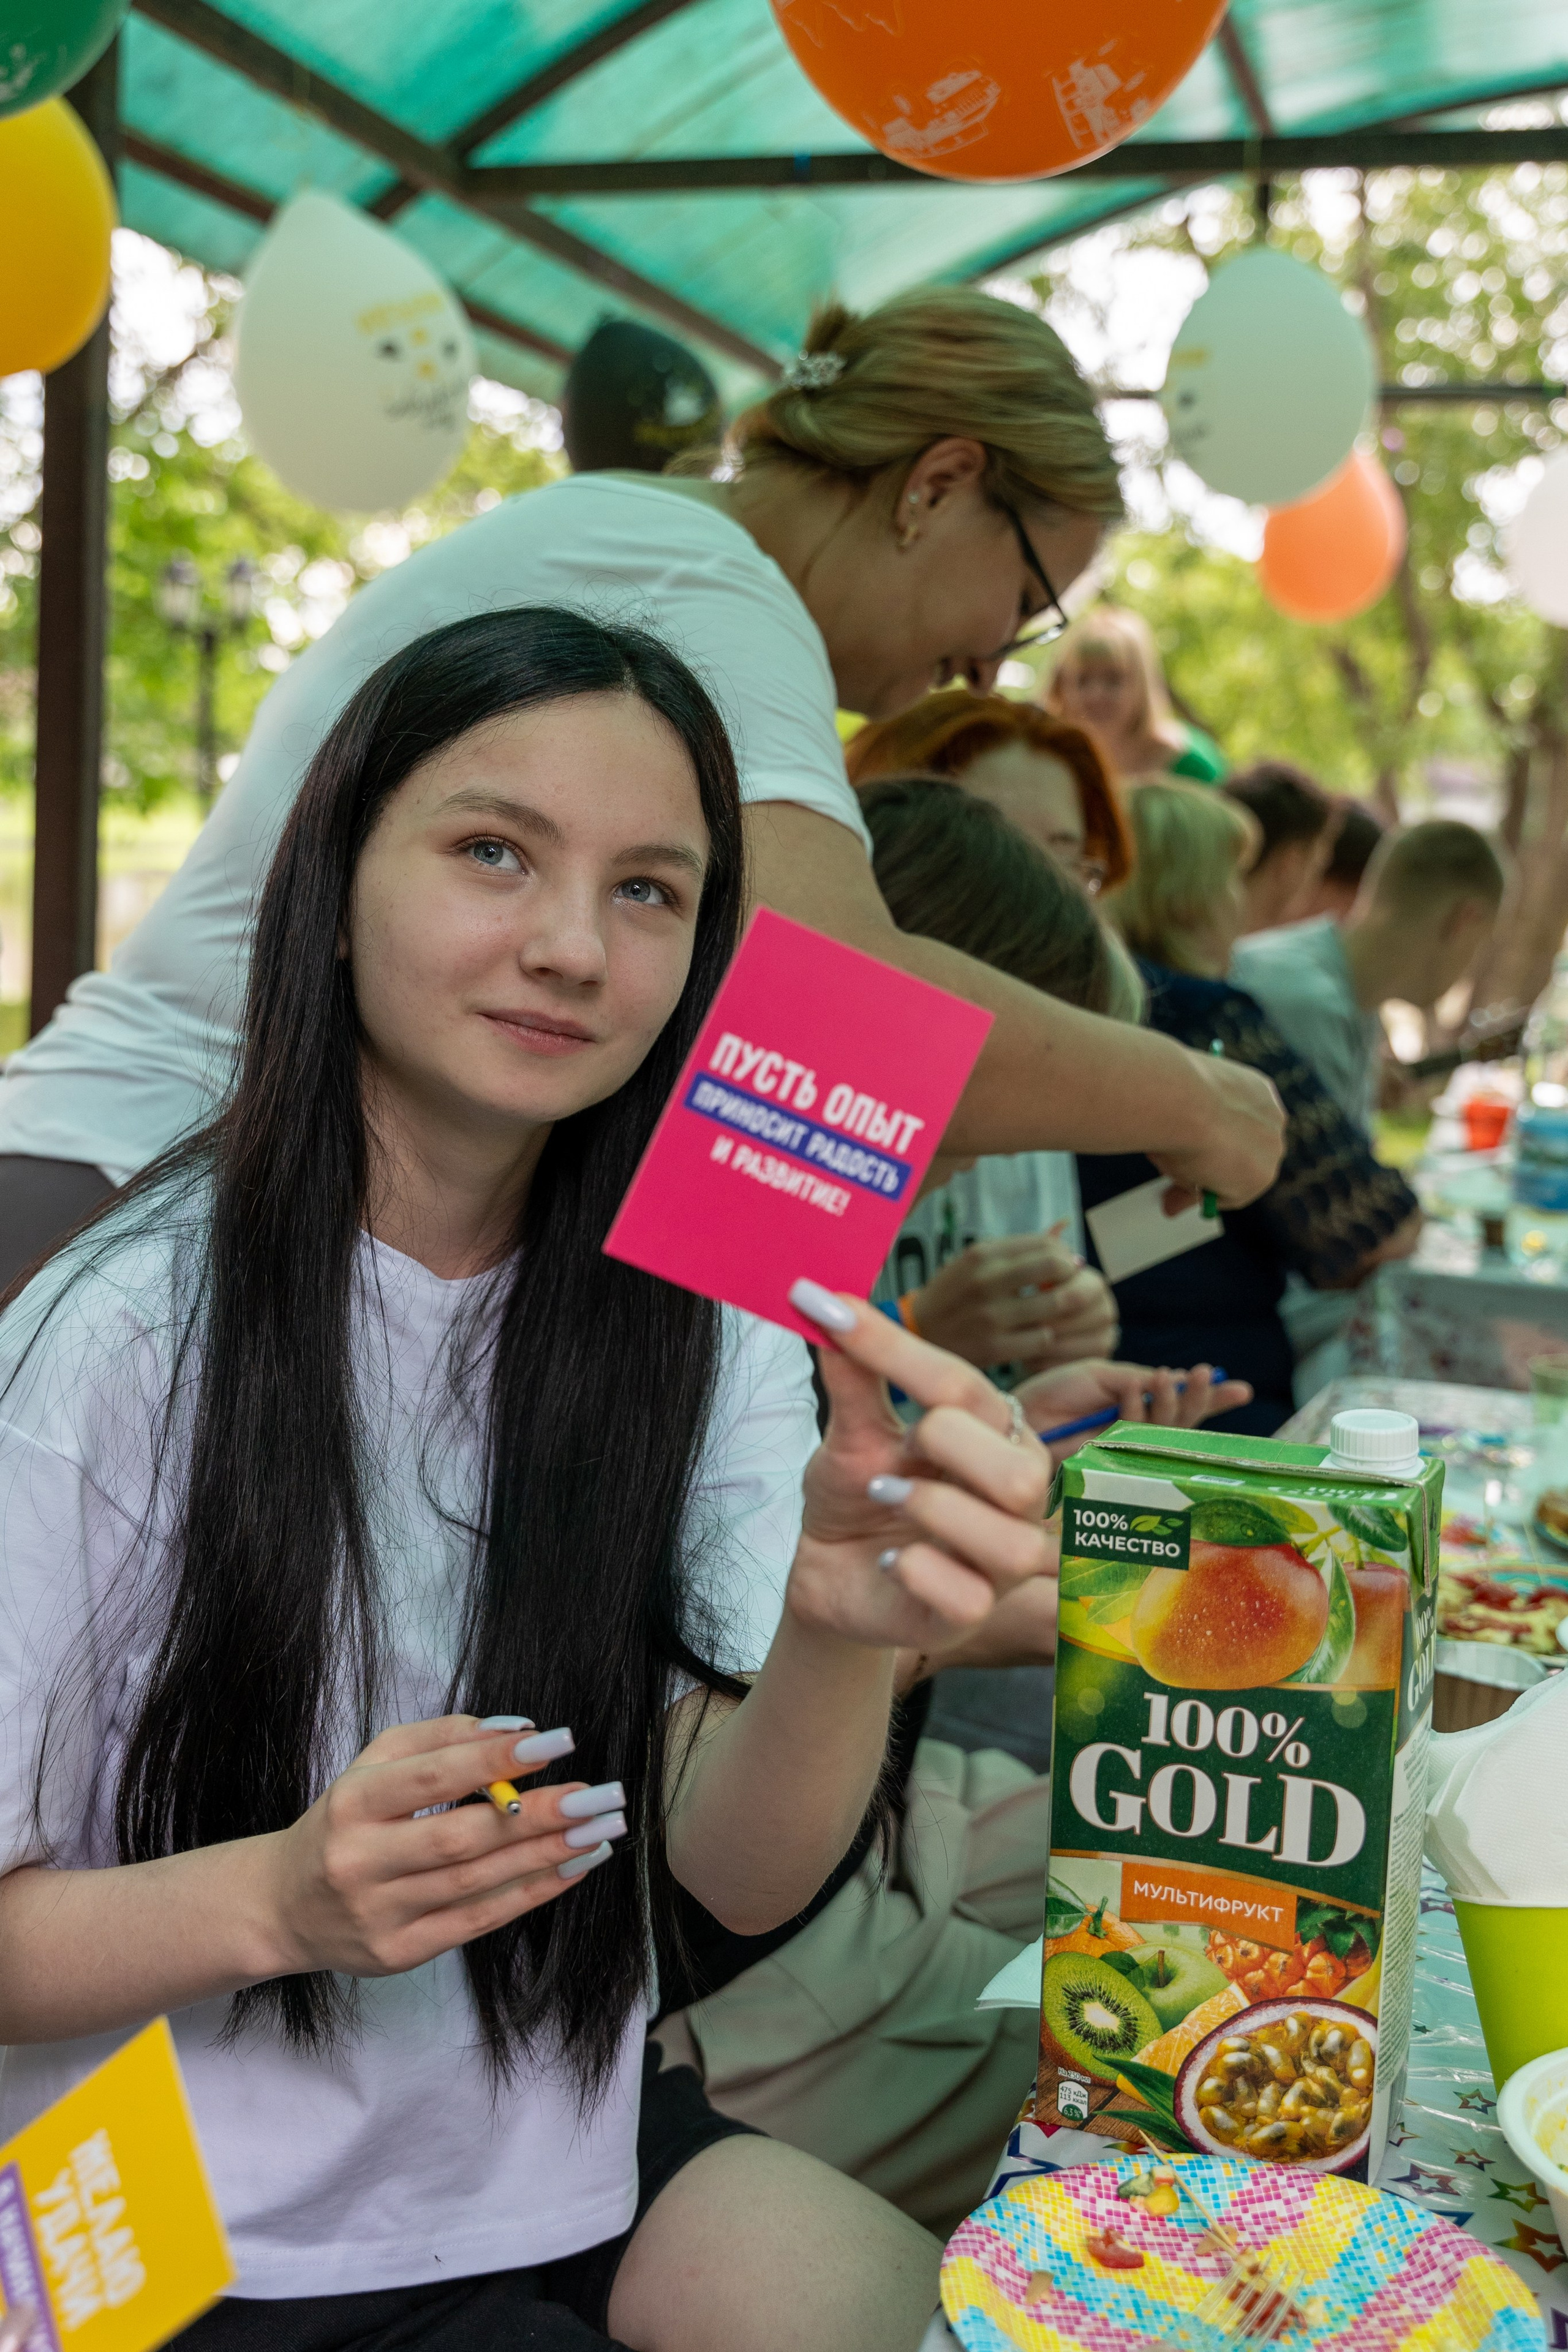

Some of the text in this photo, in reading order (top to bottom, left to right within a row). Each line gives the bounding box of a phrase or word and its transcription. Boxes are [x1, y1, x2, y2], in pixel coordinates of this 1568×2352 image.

[708, 1031, 925, 1155] ПУСТЬ ОПЫТ
[692, 1080, 899, 1193] ПРИНОСИТ РАДОСТЬ
[710, 1135, 851, 1216] И РАЗВИТИЕ!
[1073, 1509, 1128, 1531] 100%
[1075, 1531, 1181, 1558] КАЧЕСТВО
[1140, 1692, 1311, 1768] 100%
[1069, 1742, 1366, 1868] GOLD
[1134, 1880, 1284, 1922] МУЛЬТИФРУКТ
[1058, 2067, 1067, 2076] На
[1068, 2070, 1080, 2079] 250
[1060, 2086, 1071, 2094] 475
